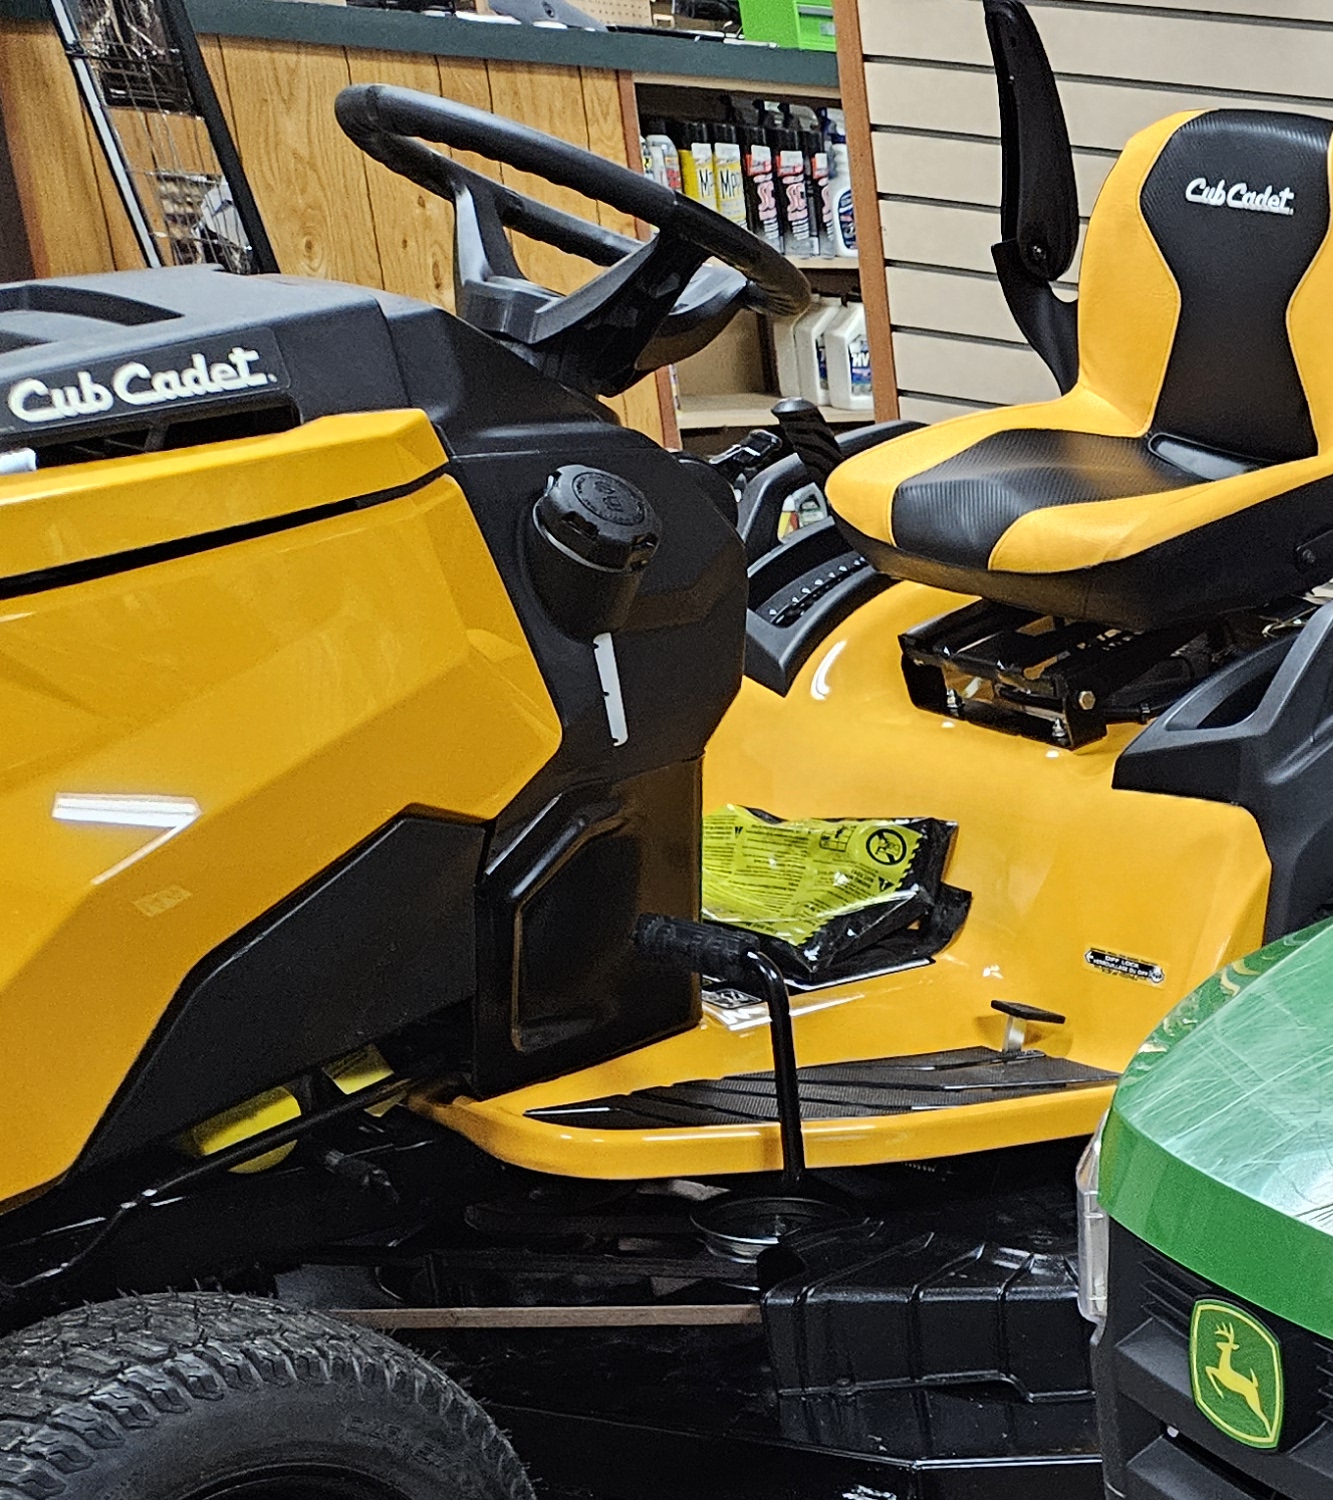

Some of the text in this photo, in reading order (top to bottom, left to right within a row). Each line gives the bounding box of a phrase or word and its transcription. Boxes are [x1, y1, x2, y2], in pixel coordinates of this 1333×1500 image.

[1185, 177, 1294, 216] Cub Cadet
[8, 370, 114, 423] Cub
